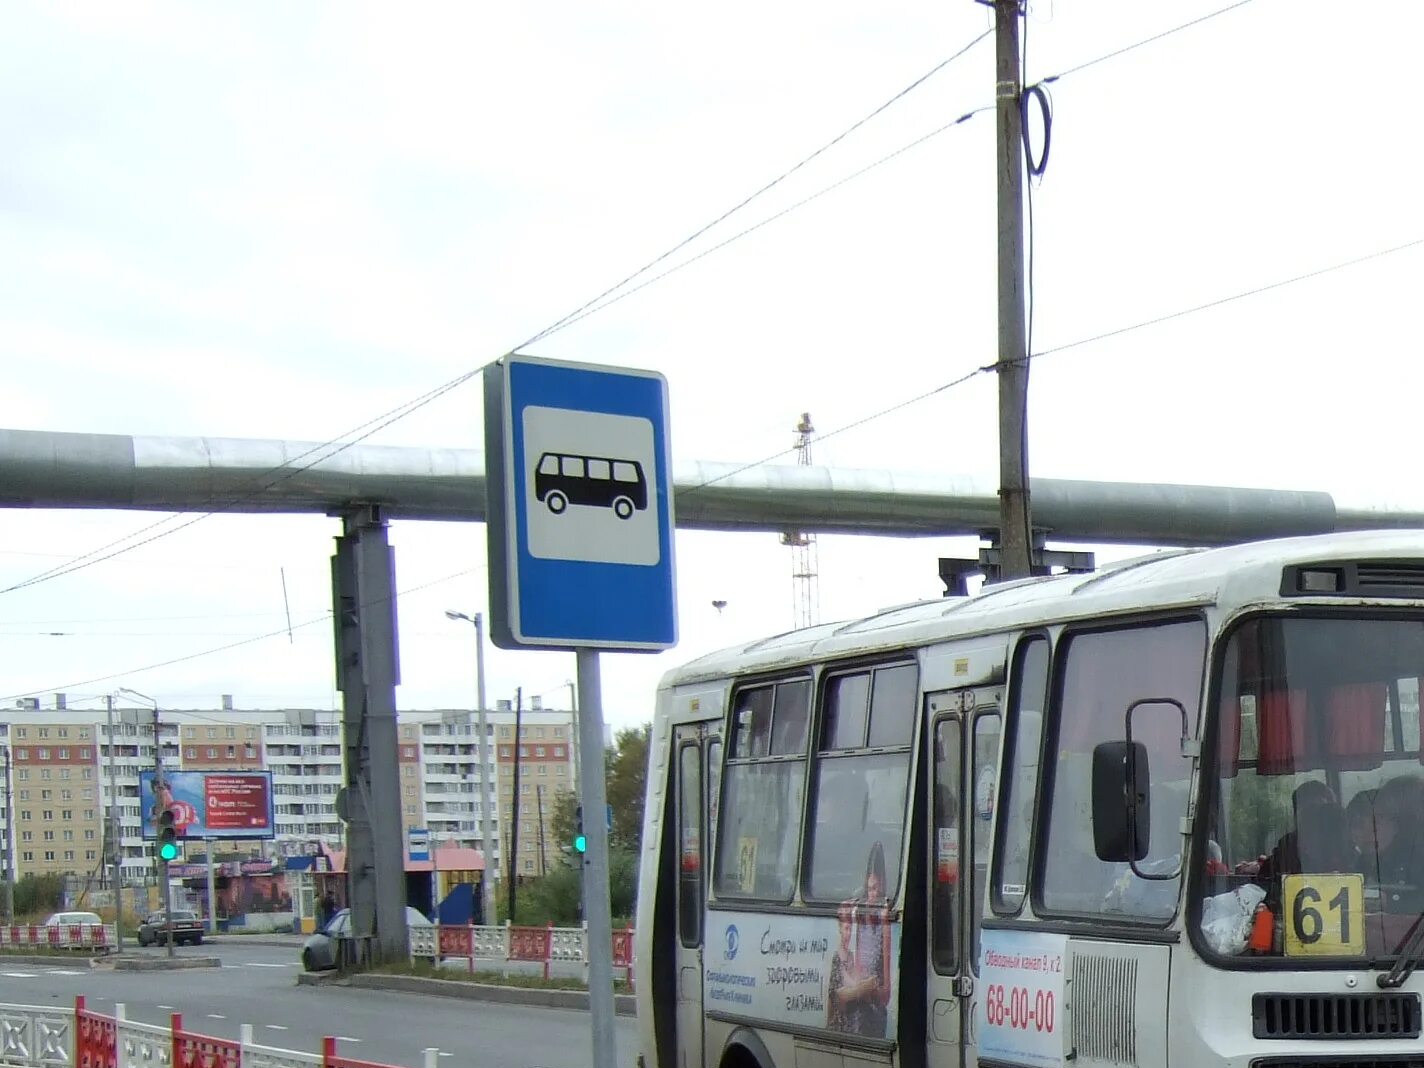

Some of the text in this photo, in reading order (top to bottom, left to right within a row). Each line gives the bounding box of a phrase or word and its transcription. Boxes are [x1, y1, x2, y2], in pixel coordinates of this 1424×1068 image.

[1293, 887, 1350, 944] 61
[761, 924, 796, 961] Смотри
[810, 938, 828, 960] мир
[985, 949, 1021, 969] Обводный
[1021, 956, 1041, 971] канал
[986, 984, 1054, 1033] 68-00-00
